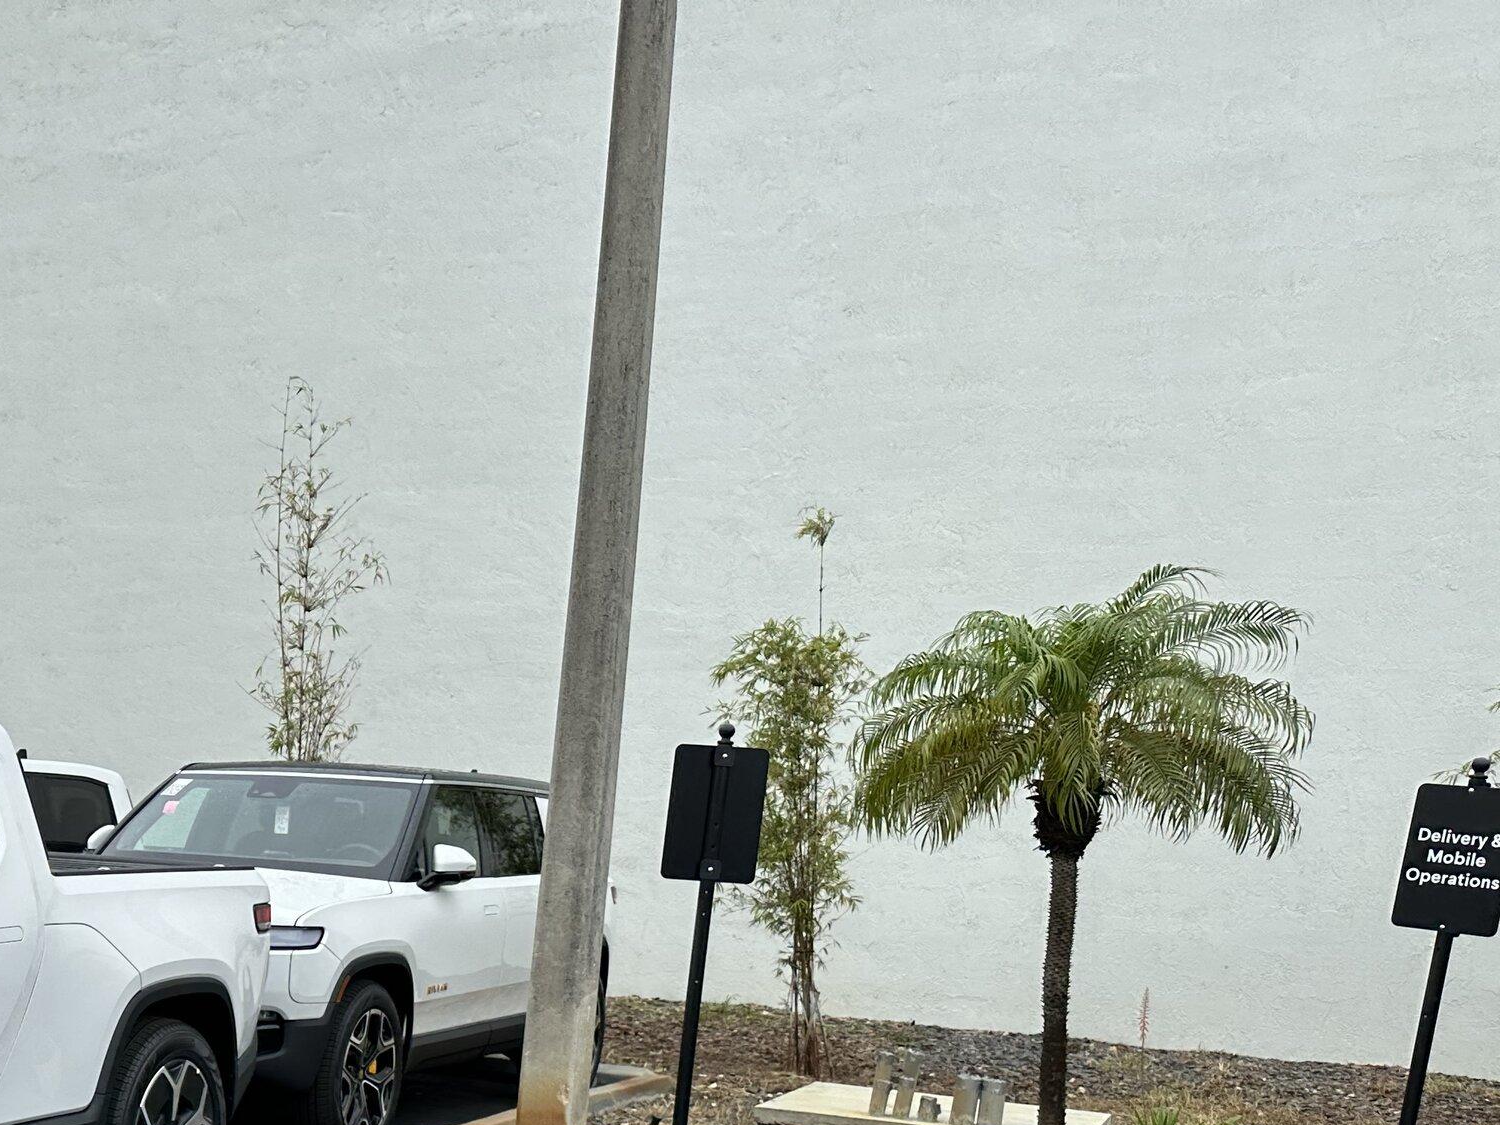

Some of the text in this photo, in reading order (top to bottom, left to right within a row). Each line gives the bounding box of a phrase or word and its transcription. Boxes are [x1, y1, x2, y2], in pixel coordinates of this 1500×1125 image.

[1417, 827, 1488, 850] Delivery
[1426, 849, 1487, 868] Mobile
[1405, 867, 1500, 890] Operations
